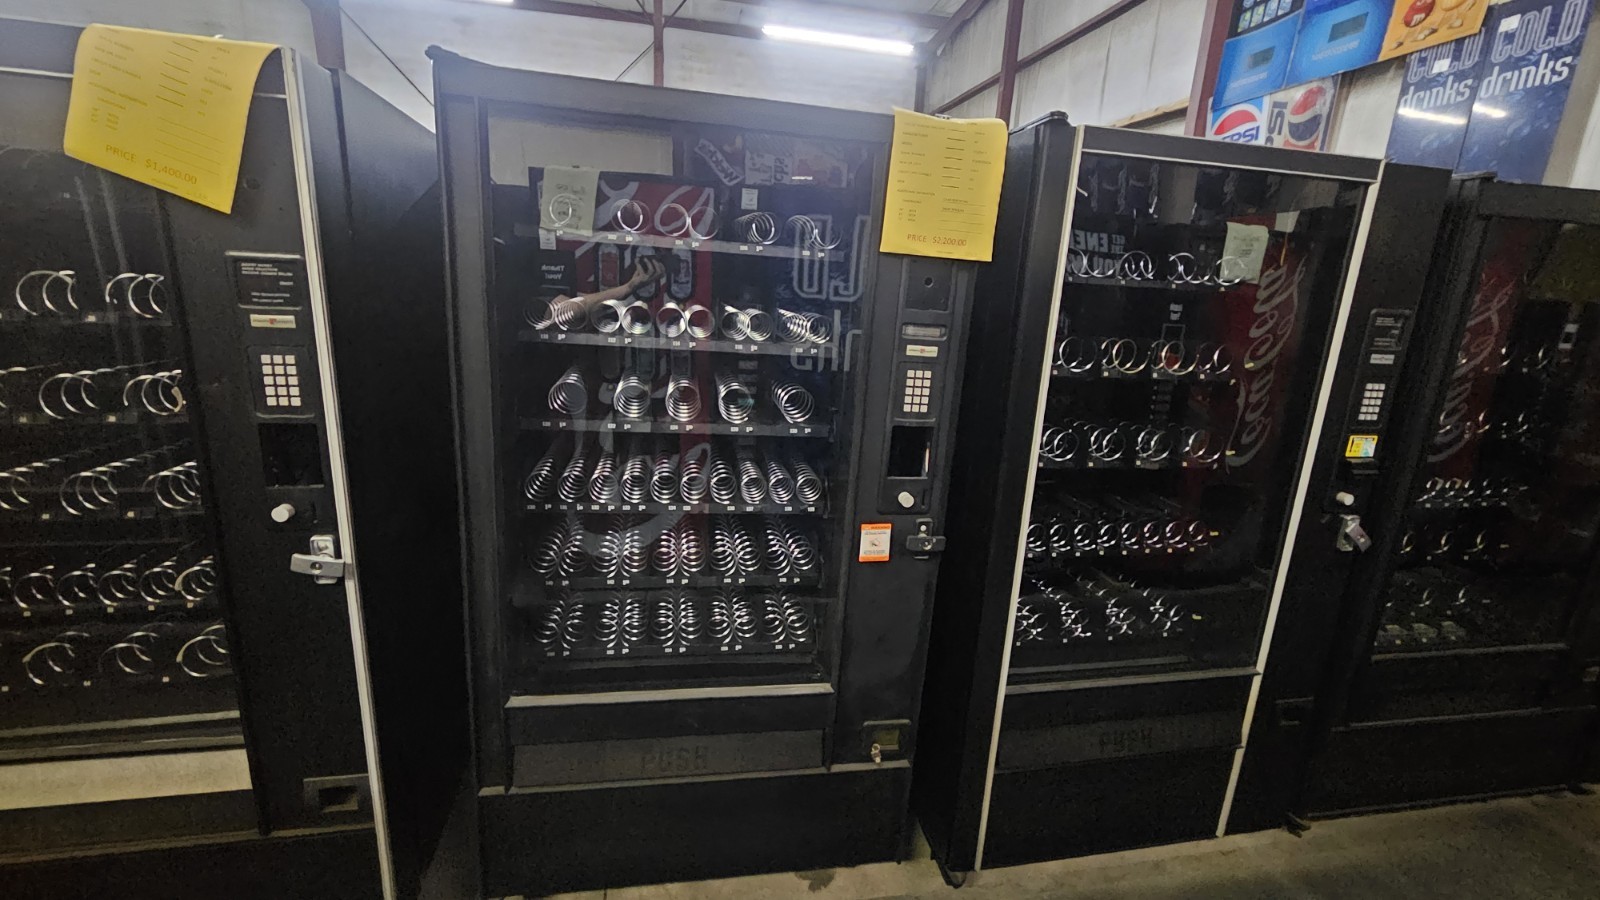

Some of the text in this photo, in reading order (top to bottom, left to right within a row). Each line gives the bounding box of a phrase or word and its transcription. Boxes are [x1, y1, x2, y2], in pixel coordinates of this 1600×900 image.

[1480, 52, 1573, 99] drinks
[1401, 76, 1473, 111] drinks
[105, 143, 198, 186] PRICE $1,400.00
[907, 233, 967, 247] PRICE $2,200.00
[641, 745, 709, 775] PUSH
